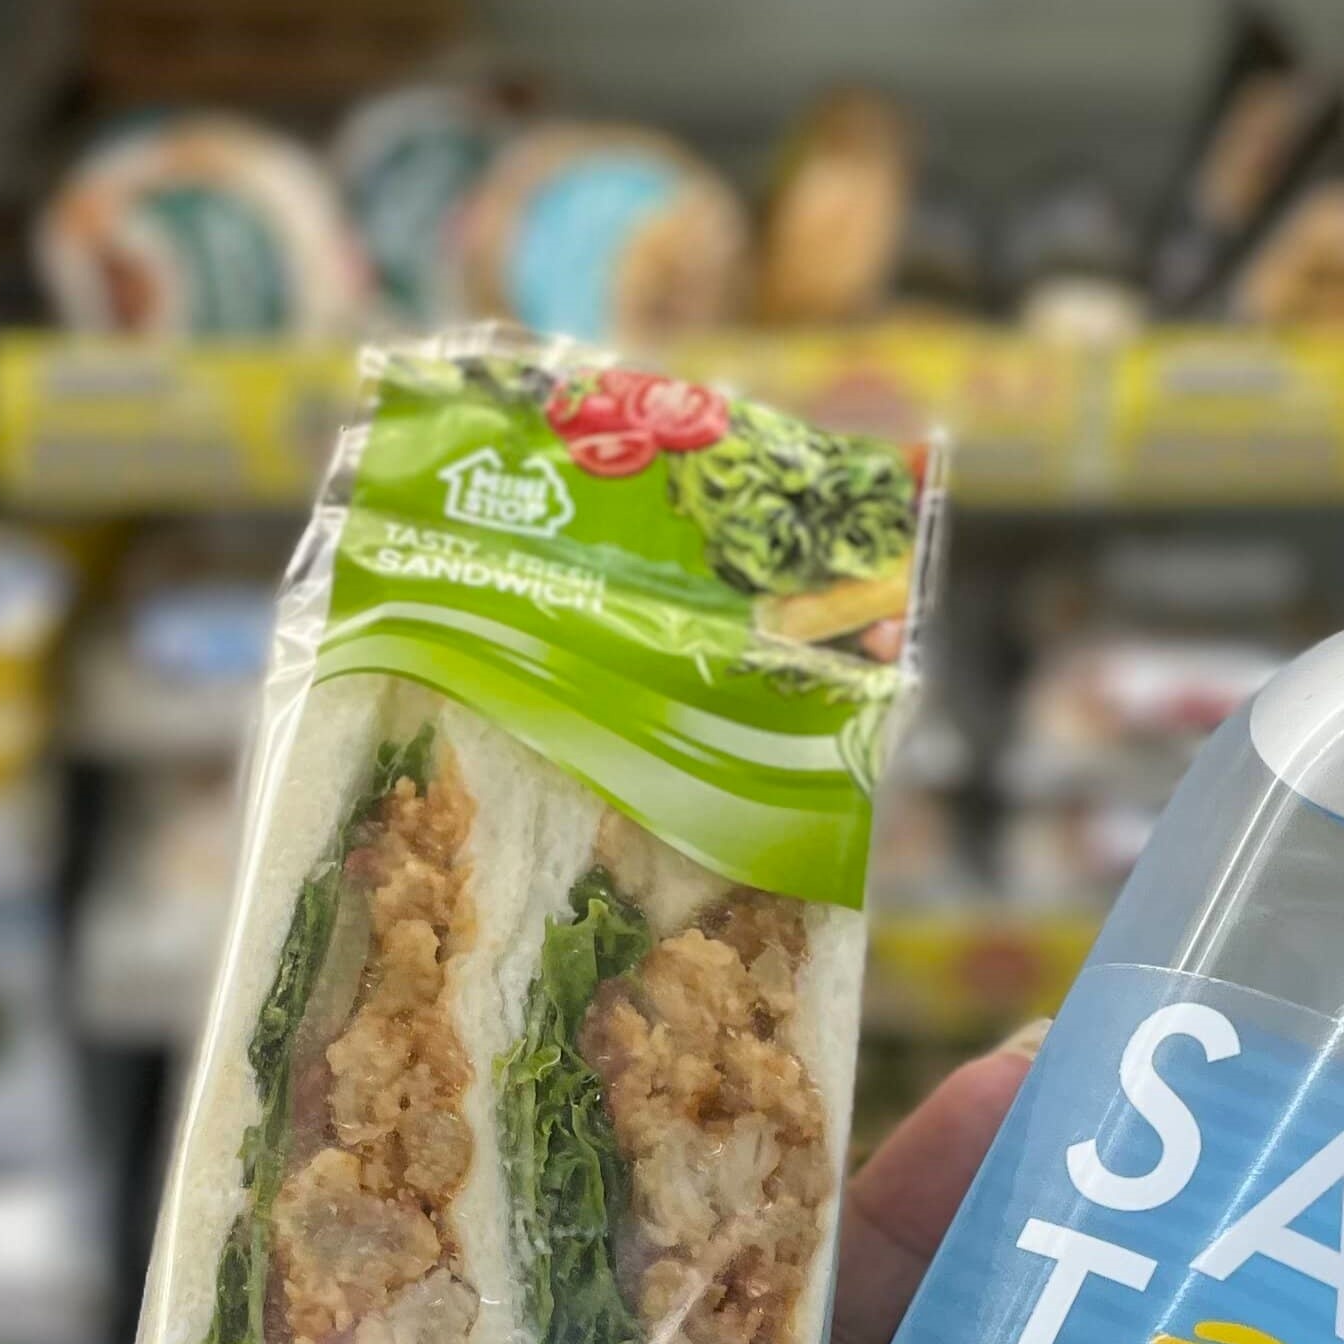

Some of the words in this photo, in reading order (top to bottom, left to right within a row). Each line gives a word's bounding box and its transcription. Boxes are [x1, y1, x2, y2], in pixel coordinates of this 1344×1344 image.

[464, 491, 547, 523] STOP
[470, 466, 548, 499] MINI
[376, 548, 604, 615] SANDWICH
[384, 522, 478, 559] TASTY
[507, 552, 606, 597] FRESH
